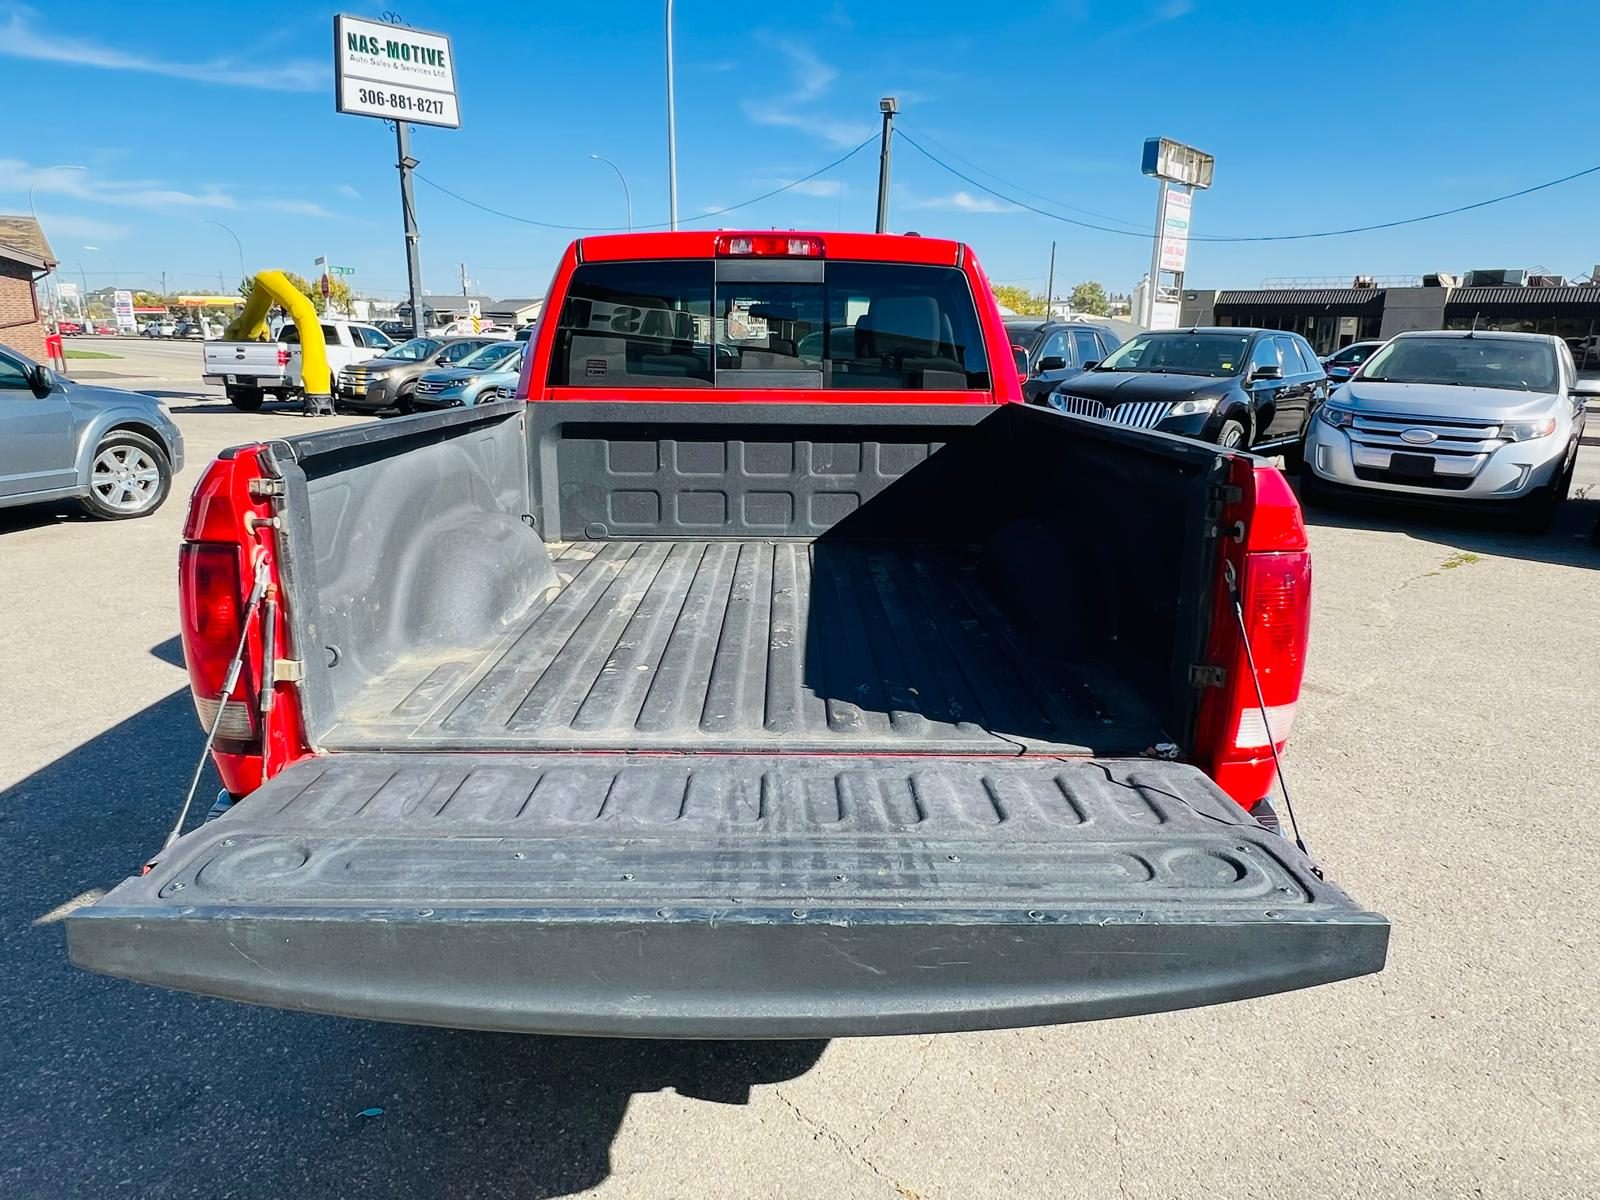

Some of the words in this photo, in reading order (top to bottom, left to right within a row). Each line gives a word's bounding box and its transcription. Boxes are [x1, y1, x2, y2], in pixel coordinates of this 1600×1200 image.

[347, 32, 446, 68] NAS-MOTIVE
[349, 54, 369, 64] Auto
[370, 57, 391, 69] Sales
[392, 62, 399, 70] &
[400, 63, 432, 75] Services
[359, 88, 444, 115] 306-881-8217
